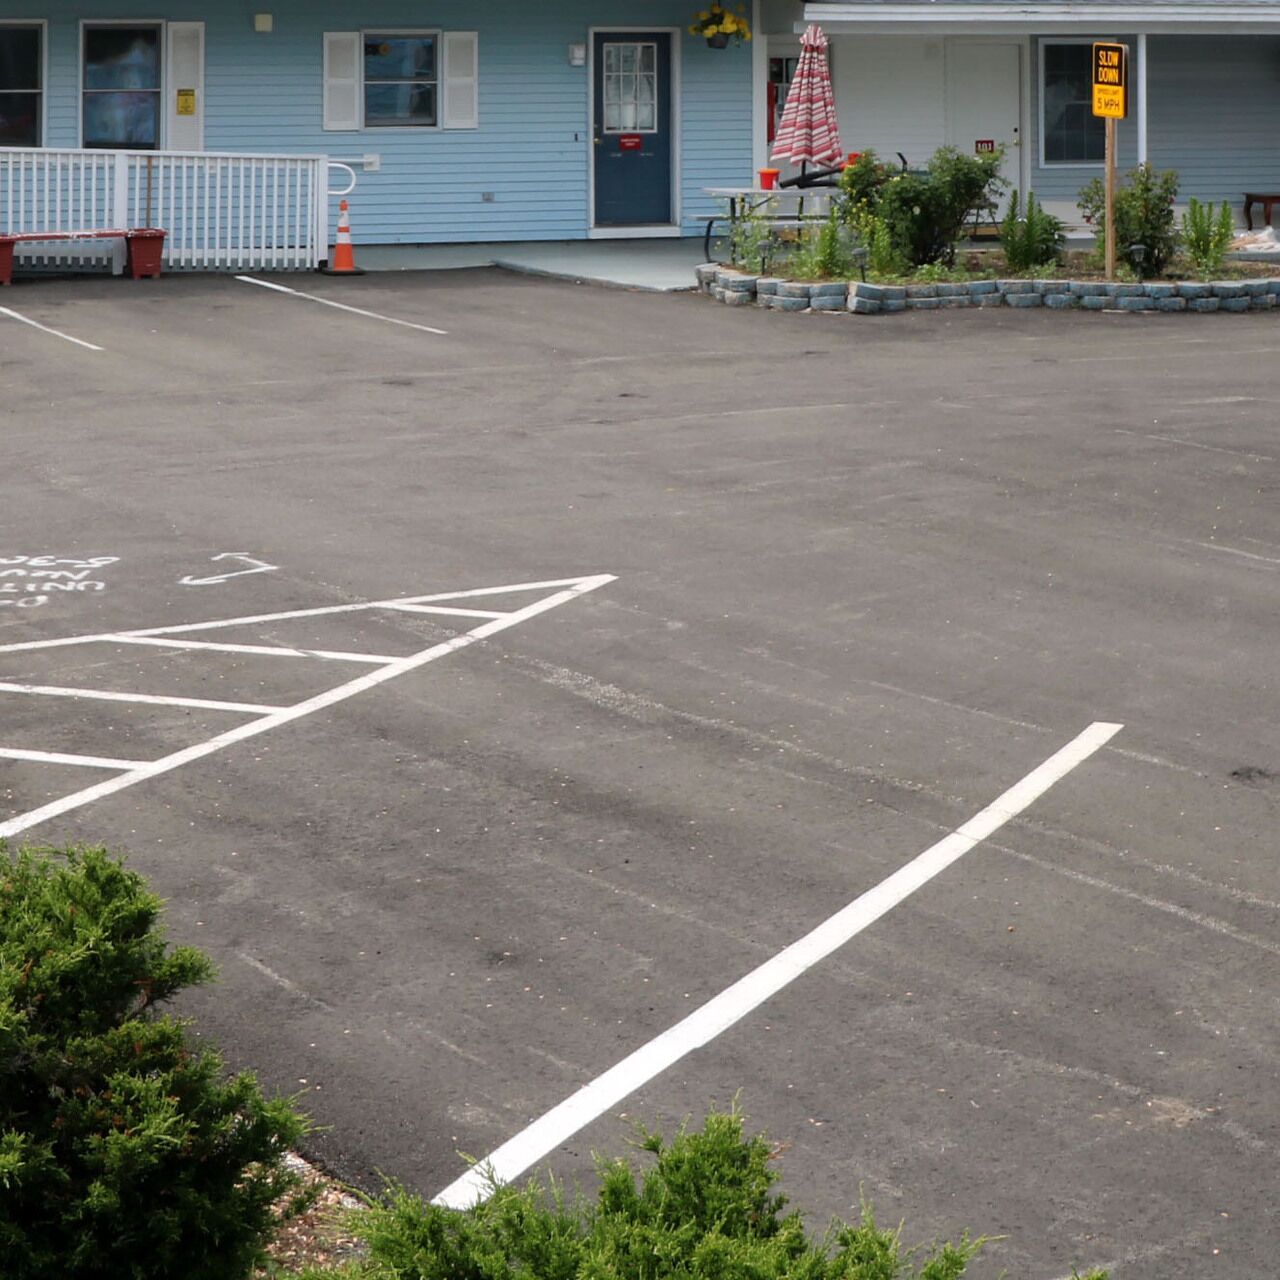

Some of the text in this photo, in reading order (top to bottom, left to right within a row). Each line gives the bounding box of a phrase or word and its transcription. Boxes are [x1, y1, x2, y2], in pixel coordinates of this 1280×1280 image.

[1099, 51, 1119, 66] SLOW
[1098, 66, 1119, 84] DOWN
[1097, 97, 1120, 112] 5 MPH
